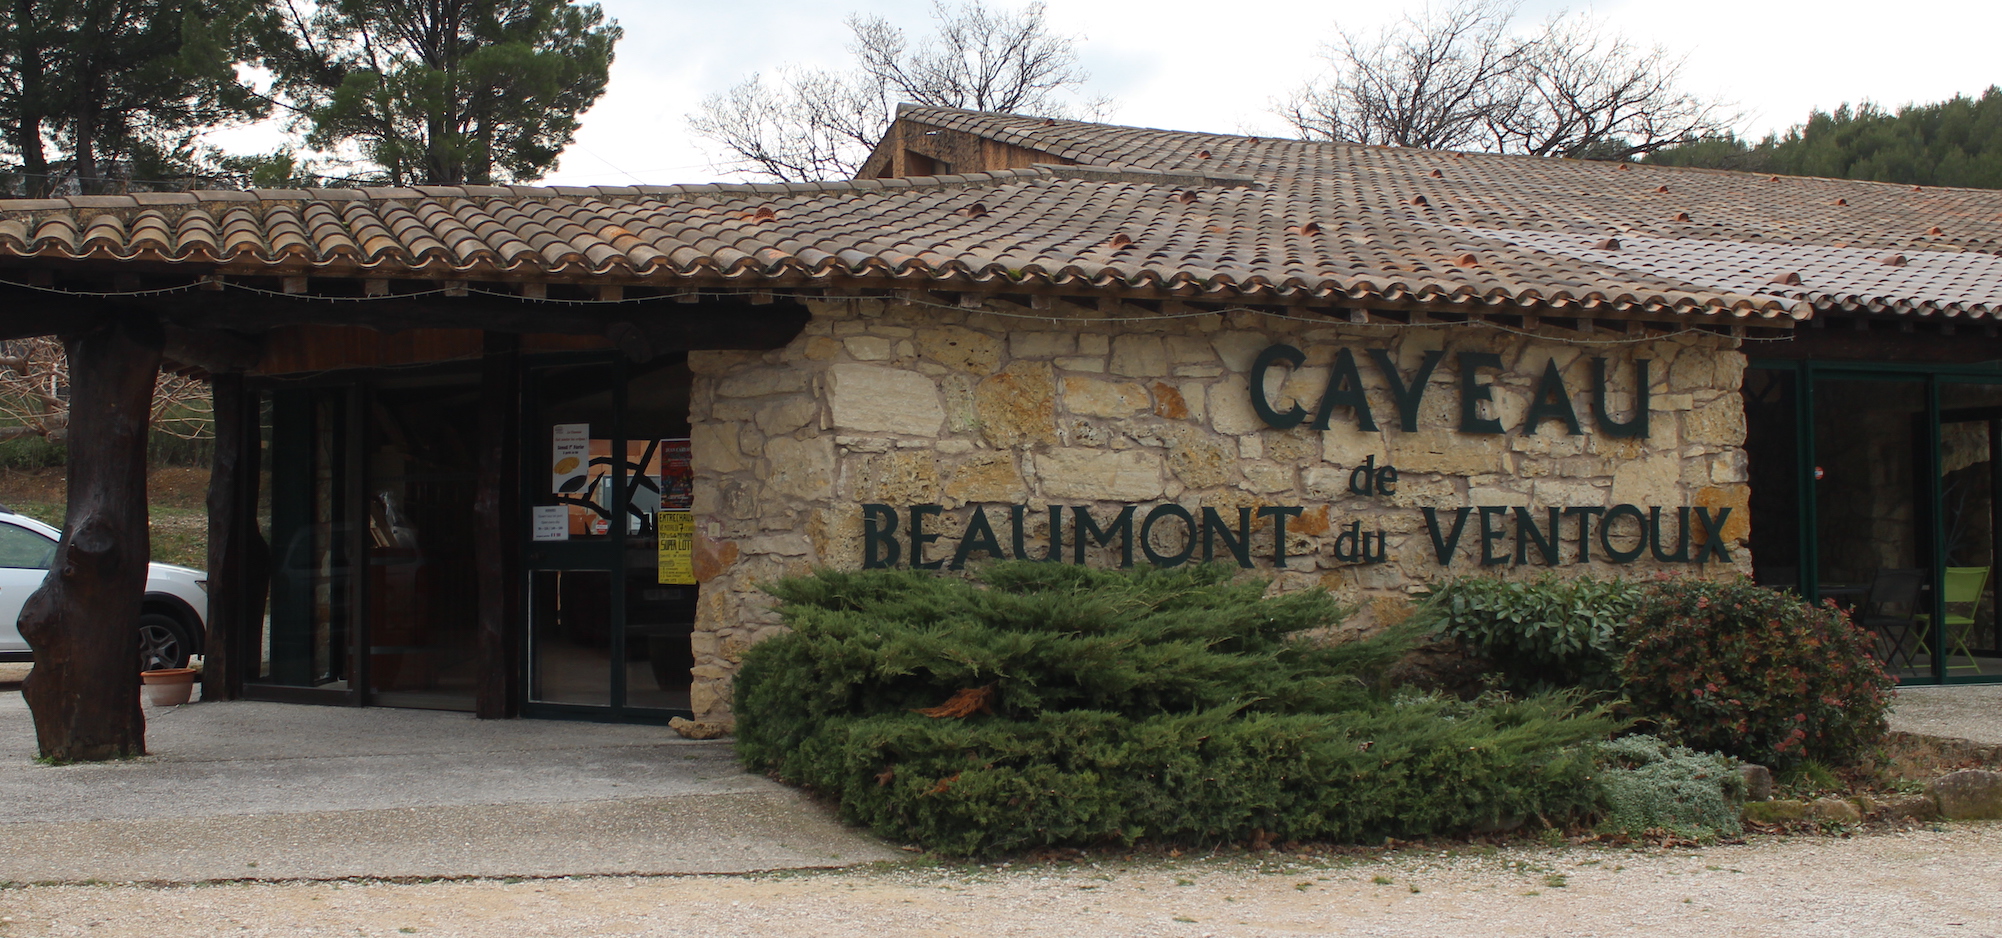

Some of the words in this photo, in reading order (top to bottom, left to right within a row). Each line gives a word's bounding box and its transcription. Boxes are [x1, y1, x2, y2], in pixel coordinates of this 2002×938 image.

[1349, 454, 1398, 497] de
[678, 523, 684, 532] 7
[862, 503, 1304, 571] BEAUMONT
[1333, 520, 1386, 564] du
[1420, 503, 1733, 567] VENTOUX
[660, 540, 678, 551] SUPER
[678, 540, 693, 551] LOT
